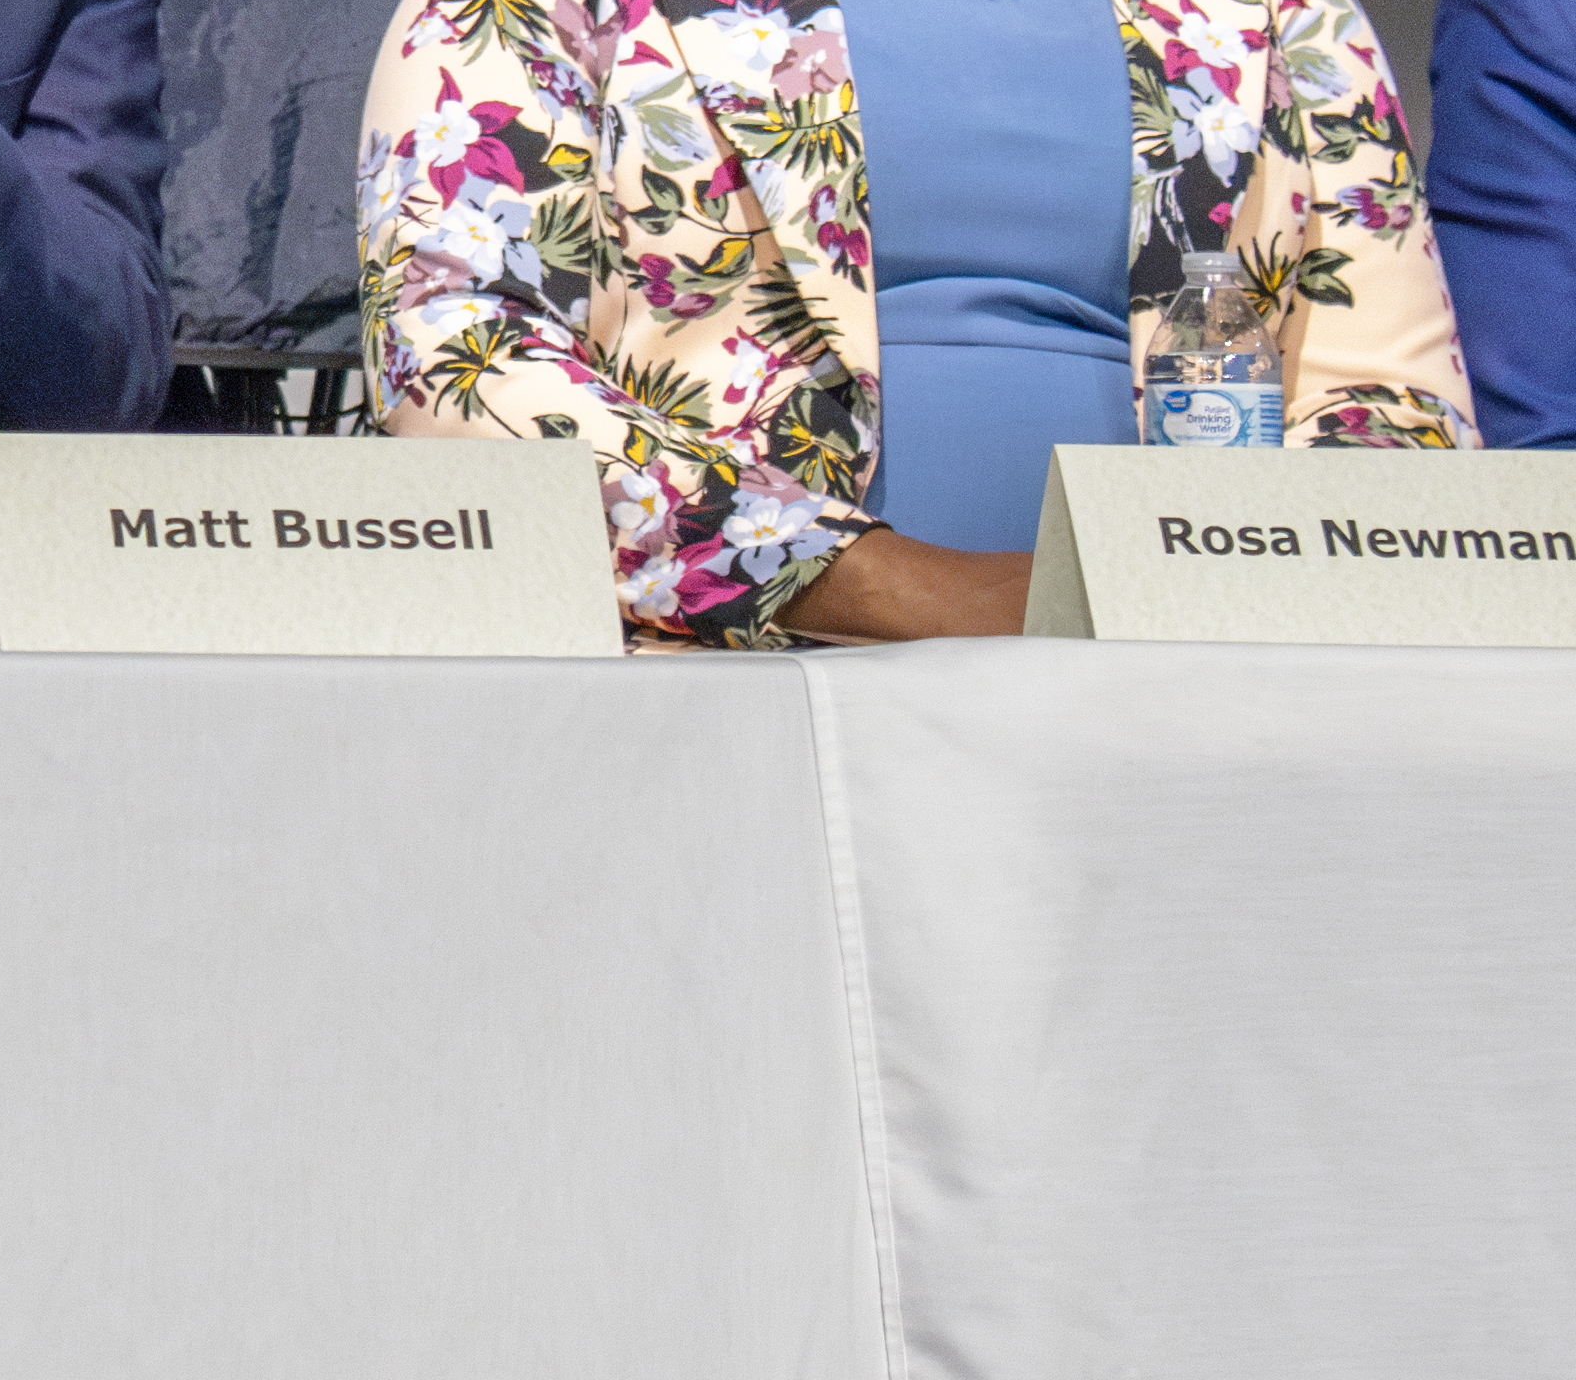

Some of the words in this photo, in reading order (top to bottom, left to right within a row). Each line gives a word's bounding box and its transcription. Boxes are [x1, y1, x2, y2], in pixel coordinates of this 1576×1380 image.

[1186, 414, 1231, 426] Drinking
[109, 507, 252, 550] Matt
[272, 508, 495, 551] Bussell
[1157, 516, 1302, 557] Rosa
[1320, 518, 1576, 562] Newman
